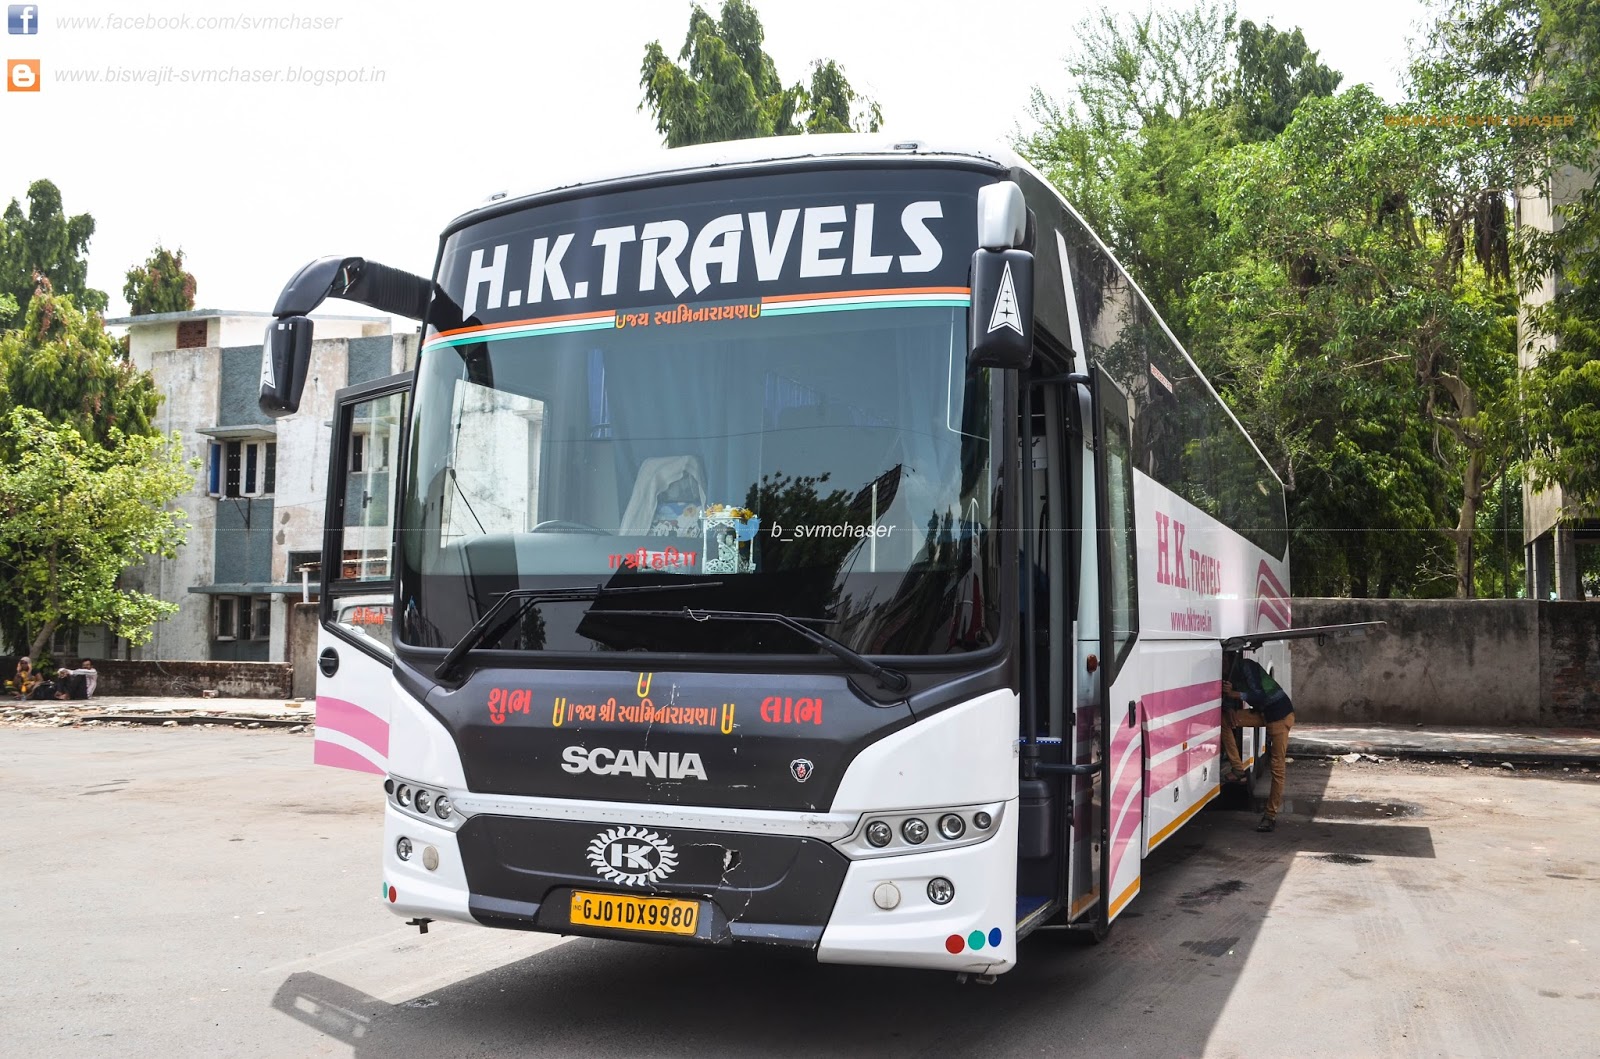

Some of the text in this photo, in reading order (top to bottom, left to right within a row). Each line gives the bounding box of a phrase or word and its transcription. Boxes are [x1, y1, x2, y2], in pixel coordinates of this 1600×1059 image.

[1189, 548, 1221, 595] TRAVELS
[487, 688, 532, 725] શુભ
[760, 696, 823, 725] લાભ
[560, 745, 709, 781] SCANIA
[583, 898, 694, 928] GJ01DX9980
